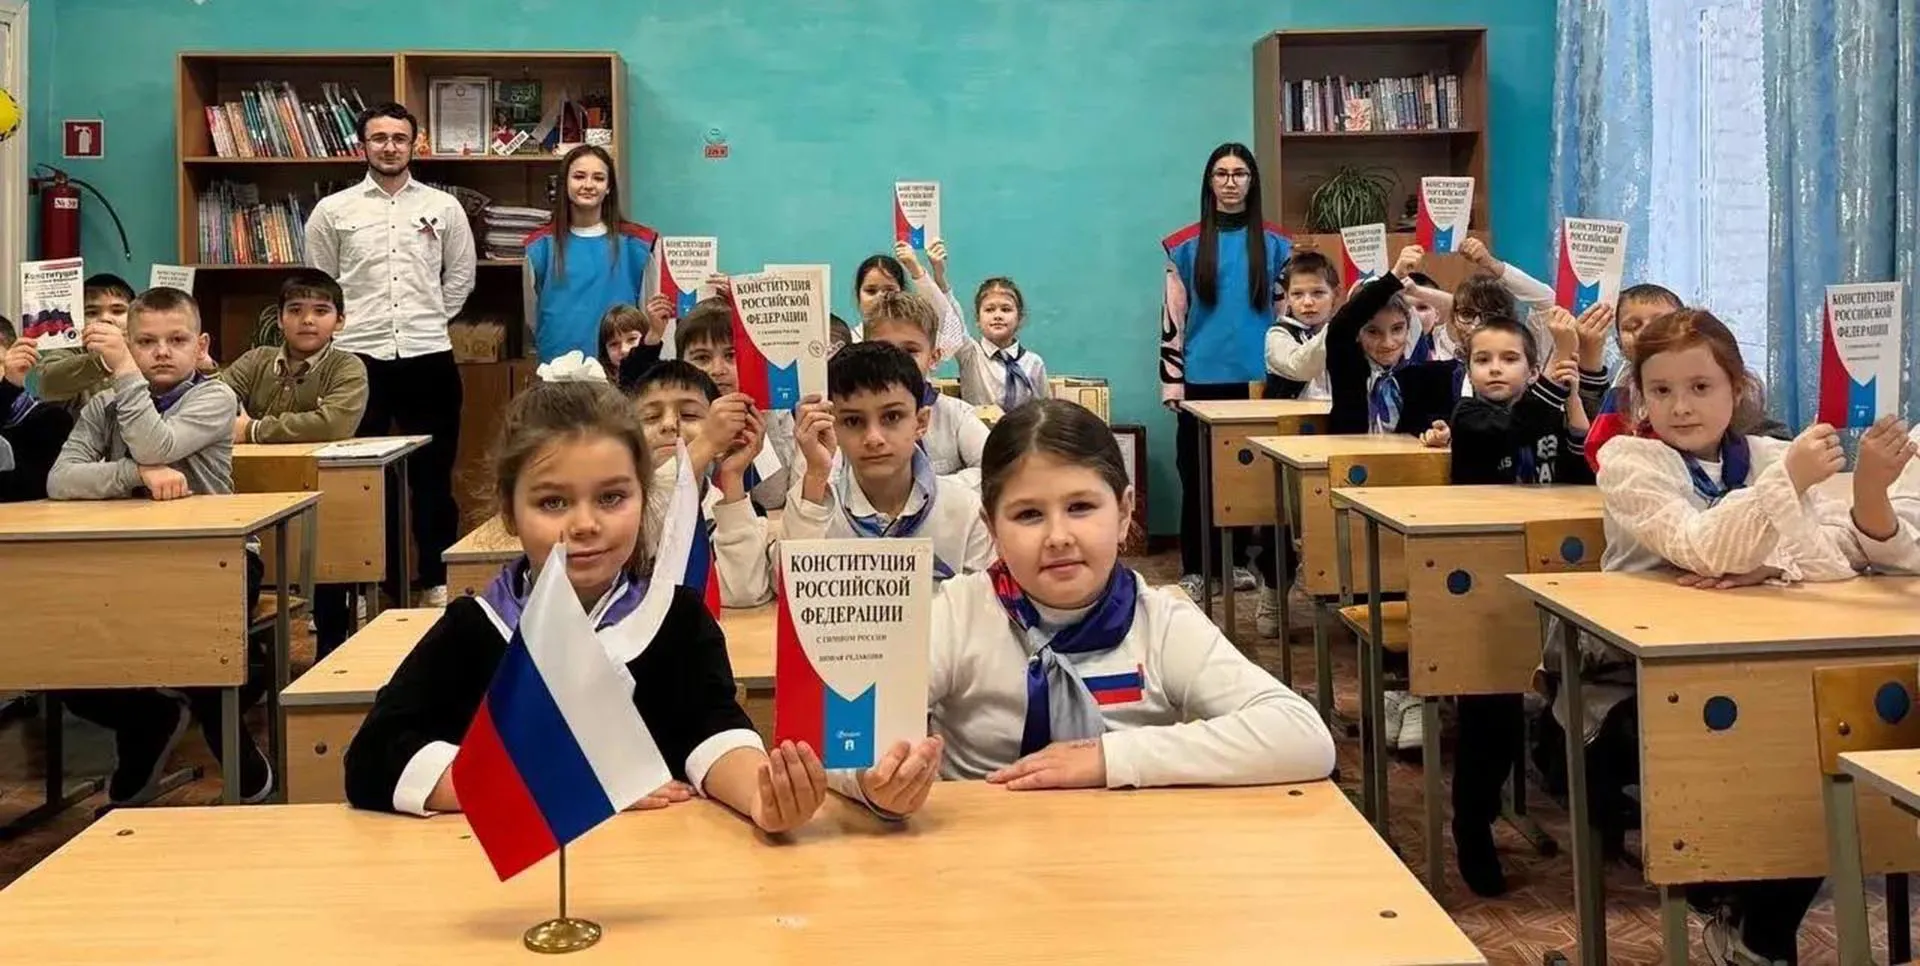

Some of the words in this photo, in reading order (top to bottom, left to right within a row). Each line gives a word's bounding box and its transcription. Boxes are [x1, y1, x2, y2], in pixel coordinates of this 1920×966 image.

[1569, 222, 1622, 233] КОНСТИТУЦИЯ
[1570, 232, 1619, 244] РОССИЙСКОЙ
[1572, 243, 1614, 253] ФЕДЕРАЦИИ
[736, 280, 811, 295] КОНСТИТУЦИЯ
[741, 293, 810, 309] РОССИЙСКОЙ
[1832, 291, 1895, 305] КОНСТИТУЦИЯ
[746, 311, 808, 324] ФЕДЕРАЦИИ
[1834, 304, 1892, 321] РОССИЙСКОЙ
[1837, 324, 1888, 338] ФЕДЕРАЦИИ
[791, 554, 916, 573] КОНСТИТУЦИЯ
[796, 576, 911, 598] РОССИЙСКОЙ
[801, 605, 903, 625] ФЕДЕРАЦИИ
